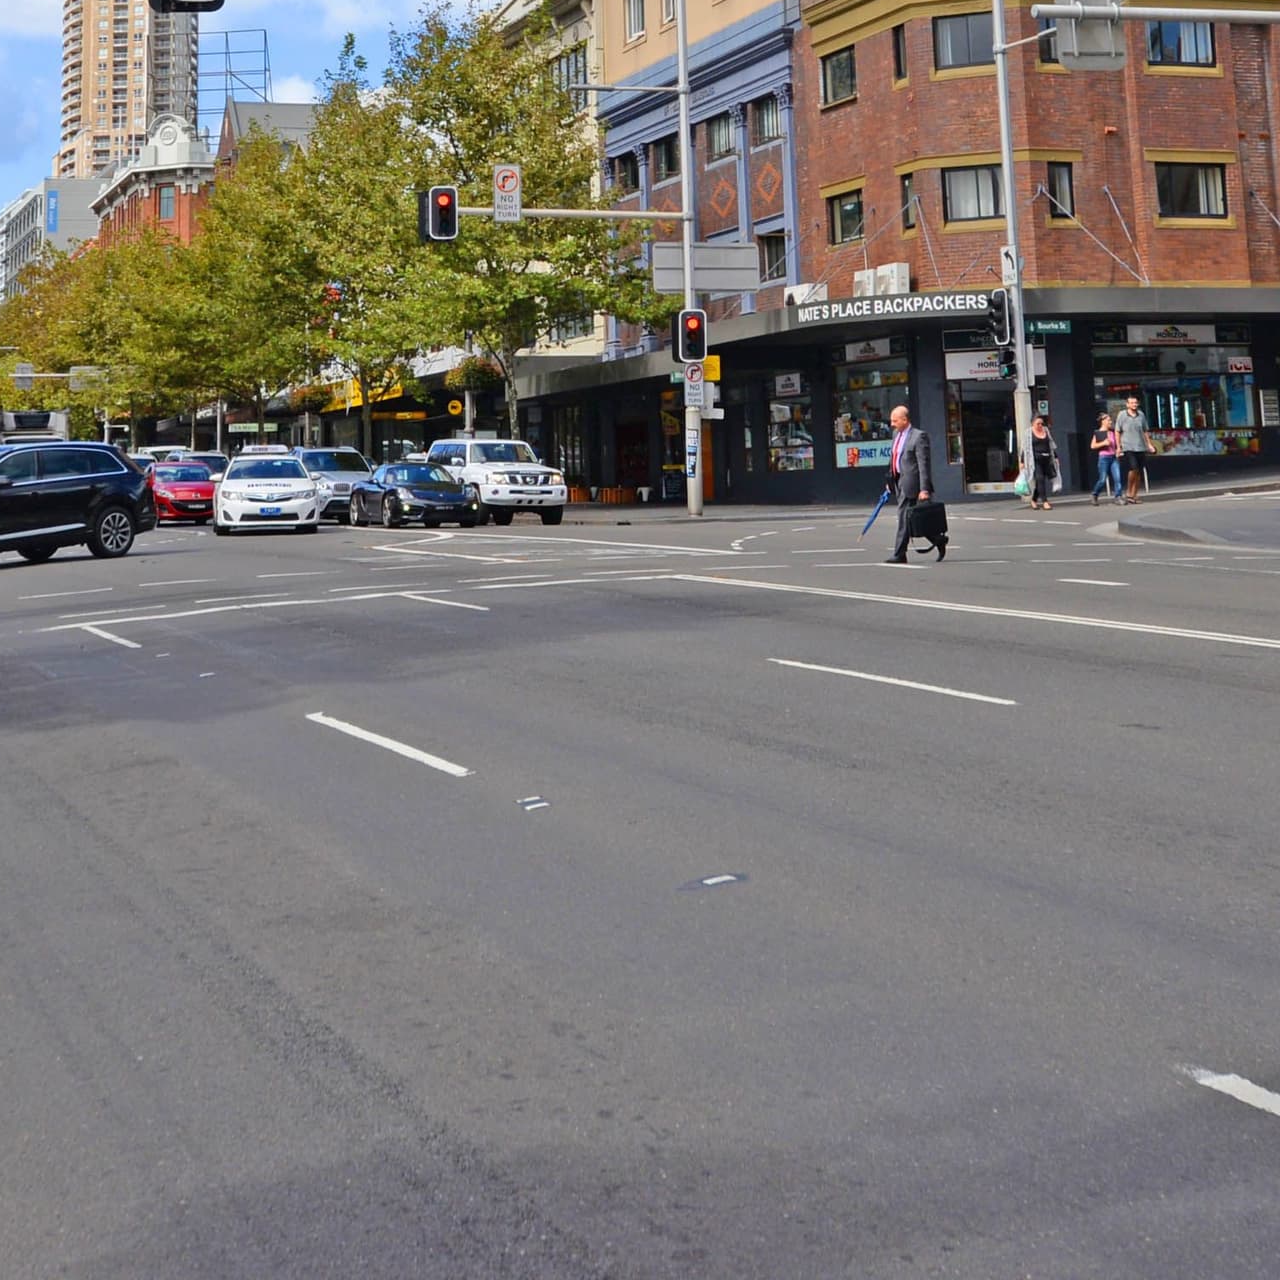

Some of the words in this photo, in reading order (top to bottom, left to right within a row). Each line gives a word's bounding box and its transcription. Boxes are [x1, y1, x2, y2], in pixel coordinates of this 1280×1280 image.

[797, 304, 830, 323] NATE'S
[831, 299, 871, 319] PLACE
[873, 294, 988, 314] BACKPACKERS
[1037, 322, 1058, 330] Bourke
